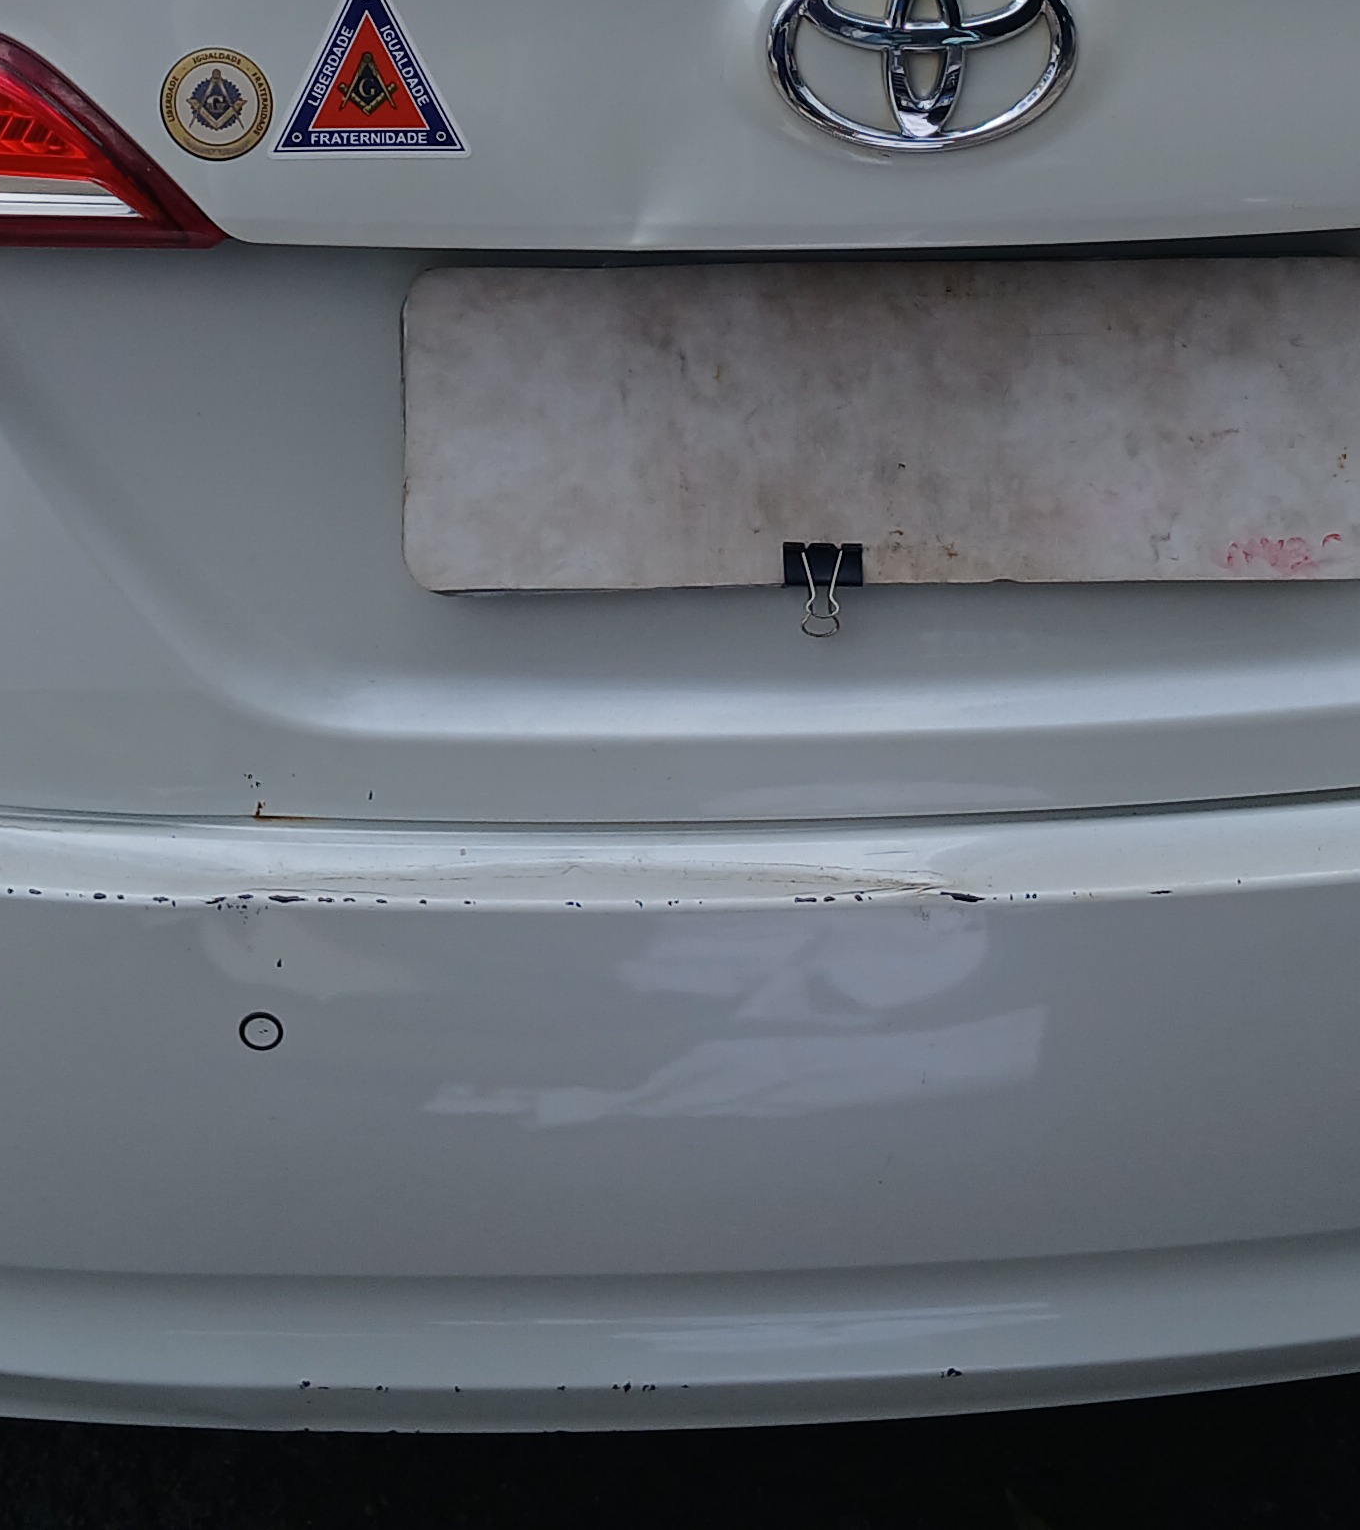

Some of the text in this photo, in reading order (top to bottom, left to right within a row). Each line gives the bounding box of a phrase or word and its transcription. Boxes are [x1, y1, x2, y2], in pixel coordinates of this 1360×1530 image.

[308, 25, 354, 108] LIBERDADE
[380, 24, 430, 107] IGUALDADE
[310, 131, 428, 146] FRATERNIDADE
